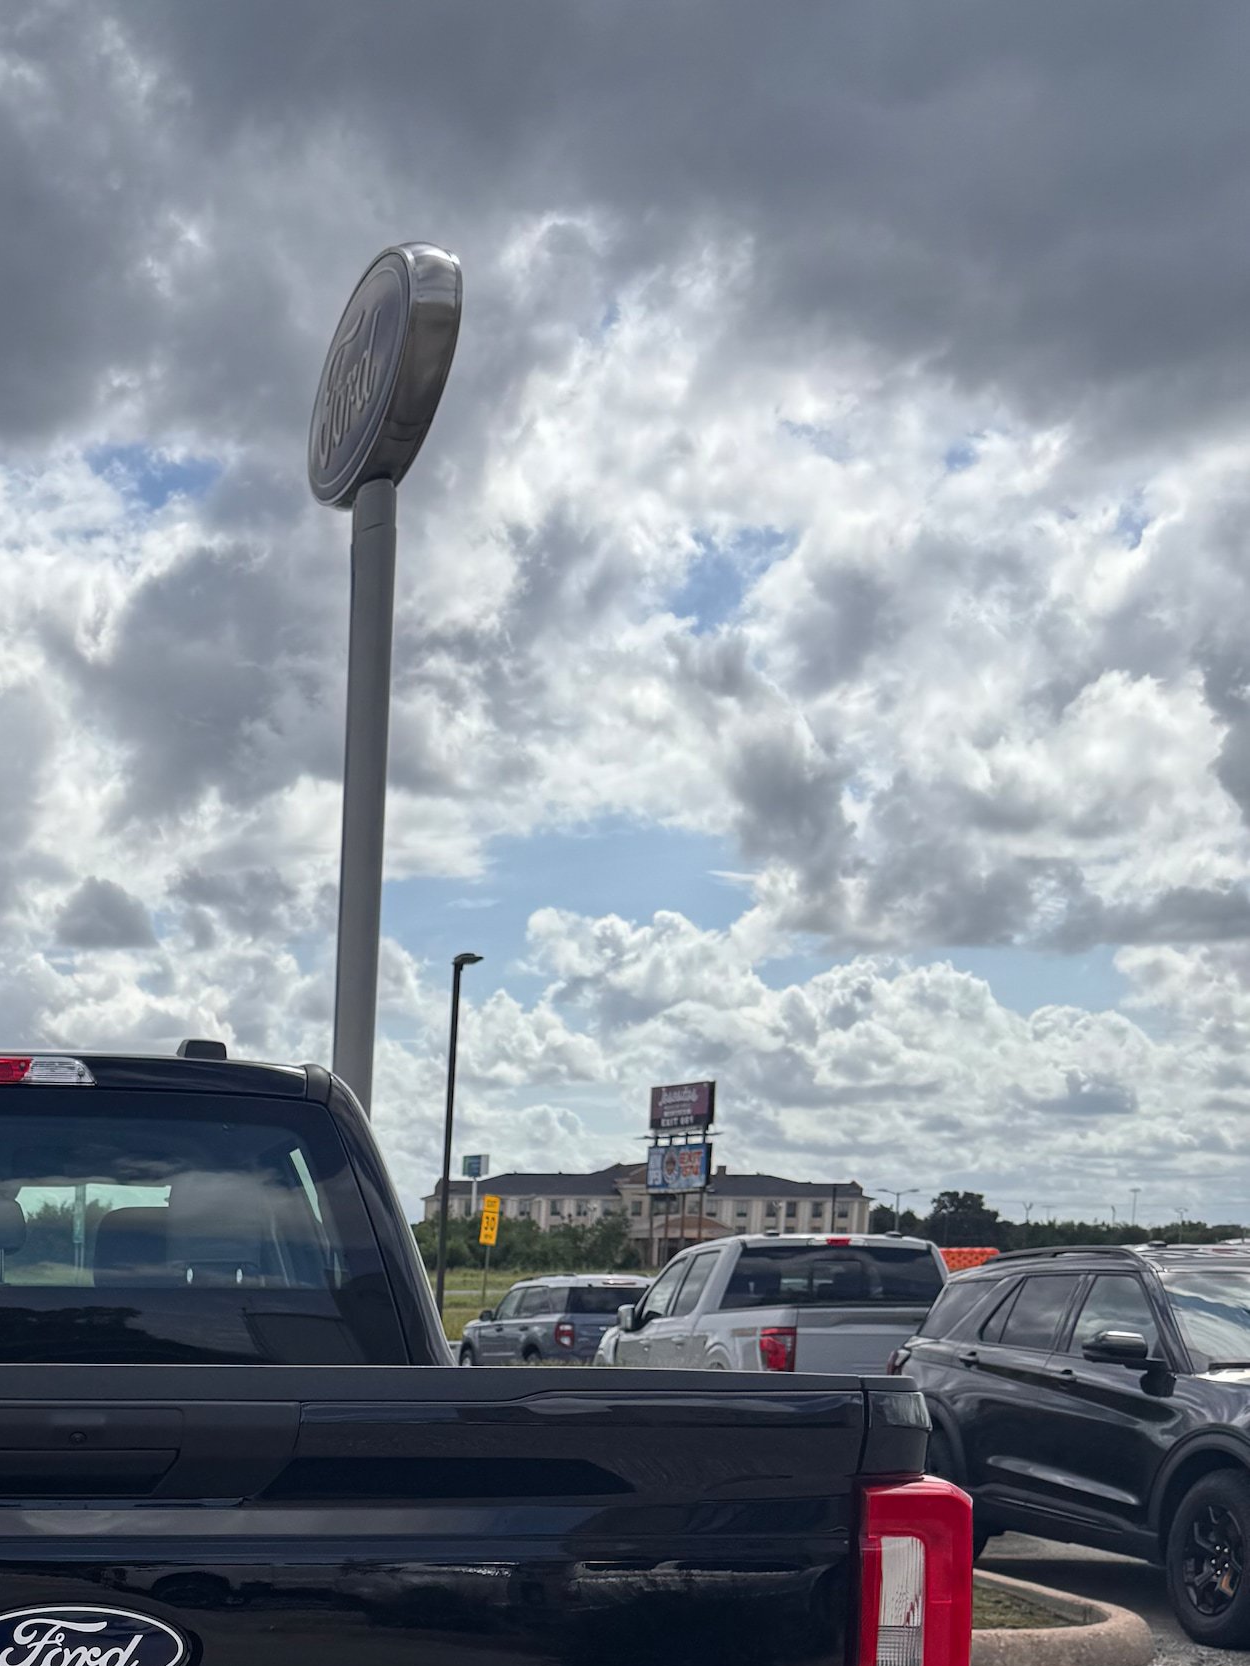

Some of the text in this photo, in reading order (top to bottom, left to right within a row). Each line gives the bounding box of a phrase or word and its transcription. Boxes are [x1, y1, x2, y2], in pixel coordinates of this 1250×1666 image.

[319, 305, 382, 470] Ford
[678, 1150, 703, 1167] EXIT
[484, 1215, 496, 1232] 30
